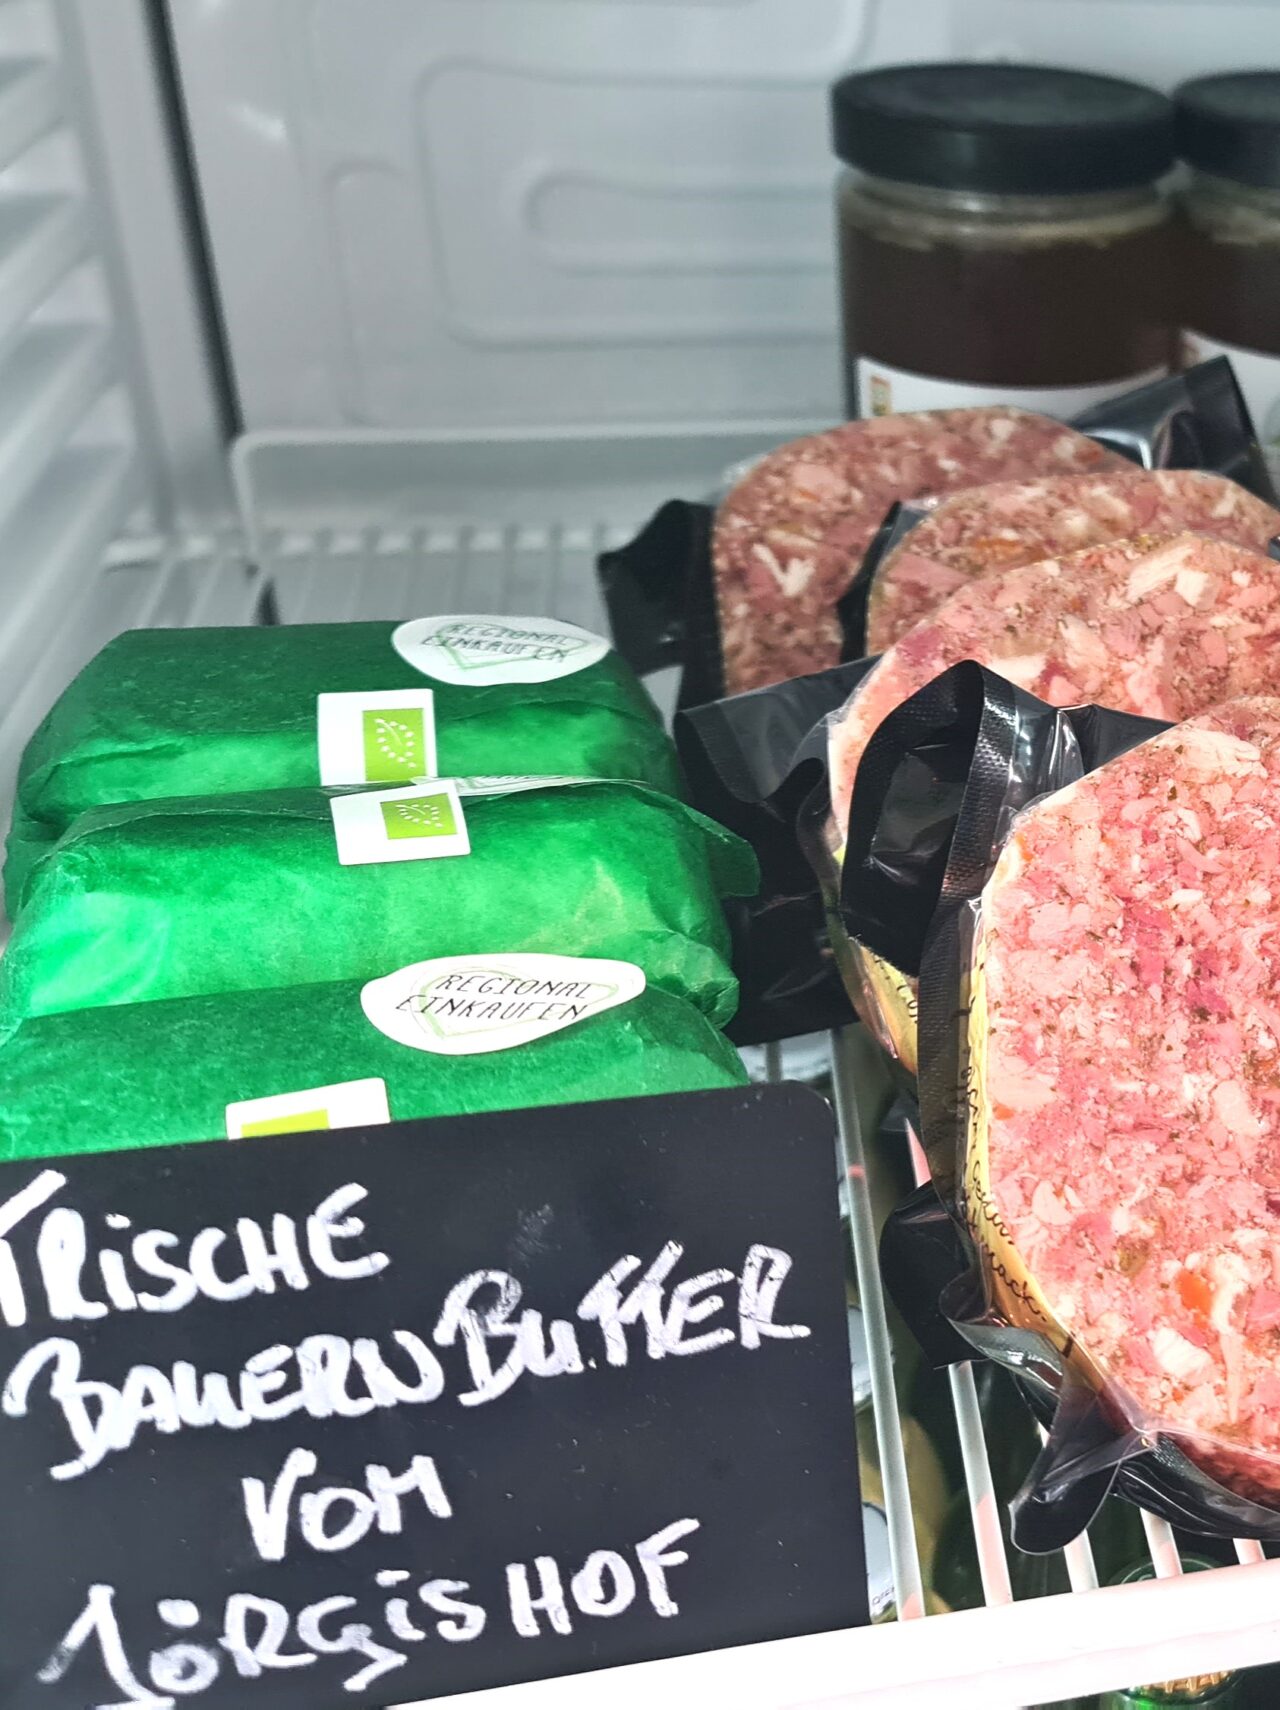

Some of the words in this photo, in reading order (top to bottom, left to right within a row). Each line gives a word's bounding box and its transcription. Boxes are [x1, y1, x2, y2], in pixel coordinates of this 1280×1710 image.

[421, 635, 570, 662] EINKAUFEN
[449, 623, 573, 647] REGIONAL
[435, 974, 592, 999] REGIONAL
[395, 994, 589, 1021] EINKAUFEN
[241, 1447, 453, 1562] VOM
